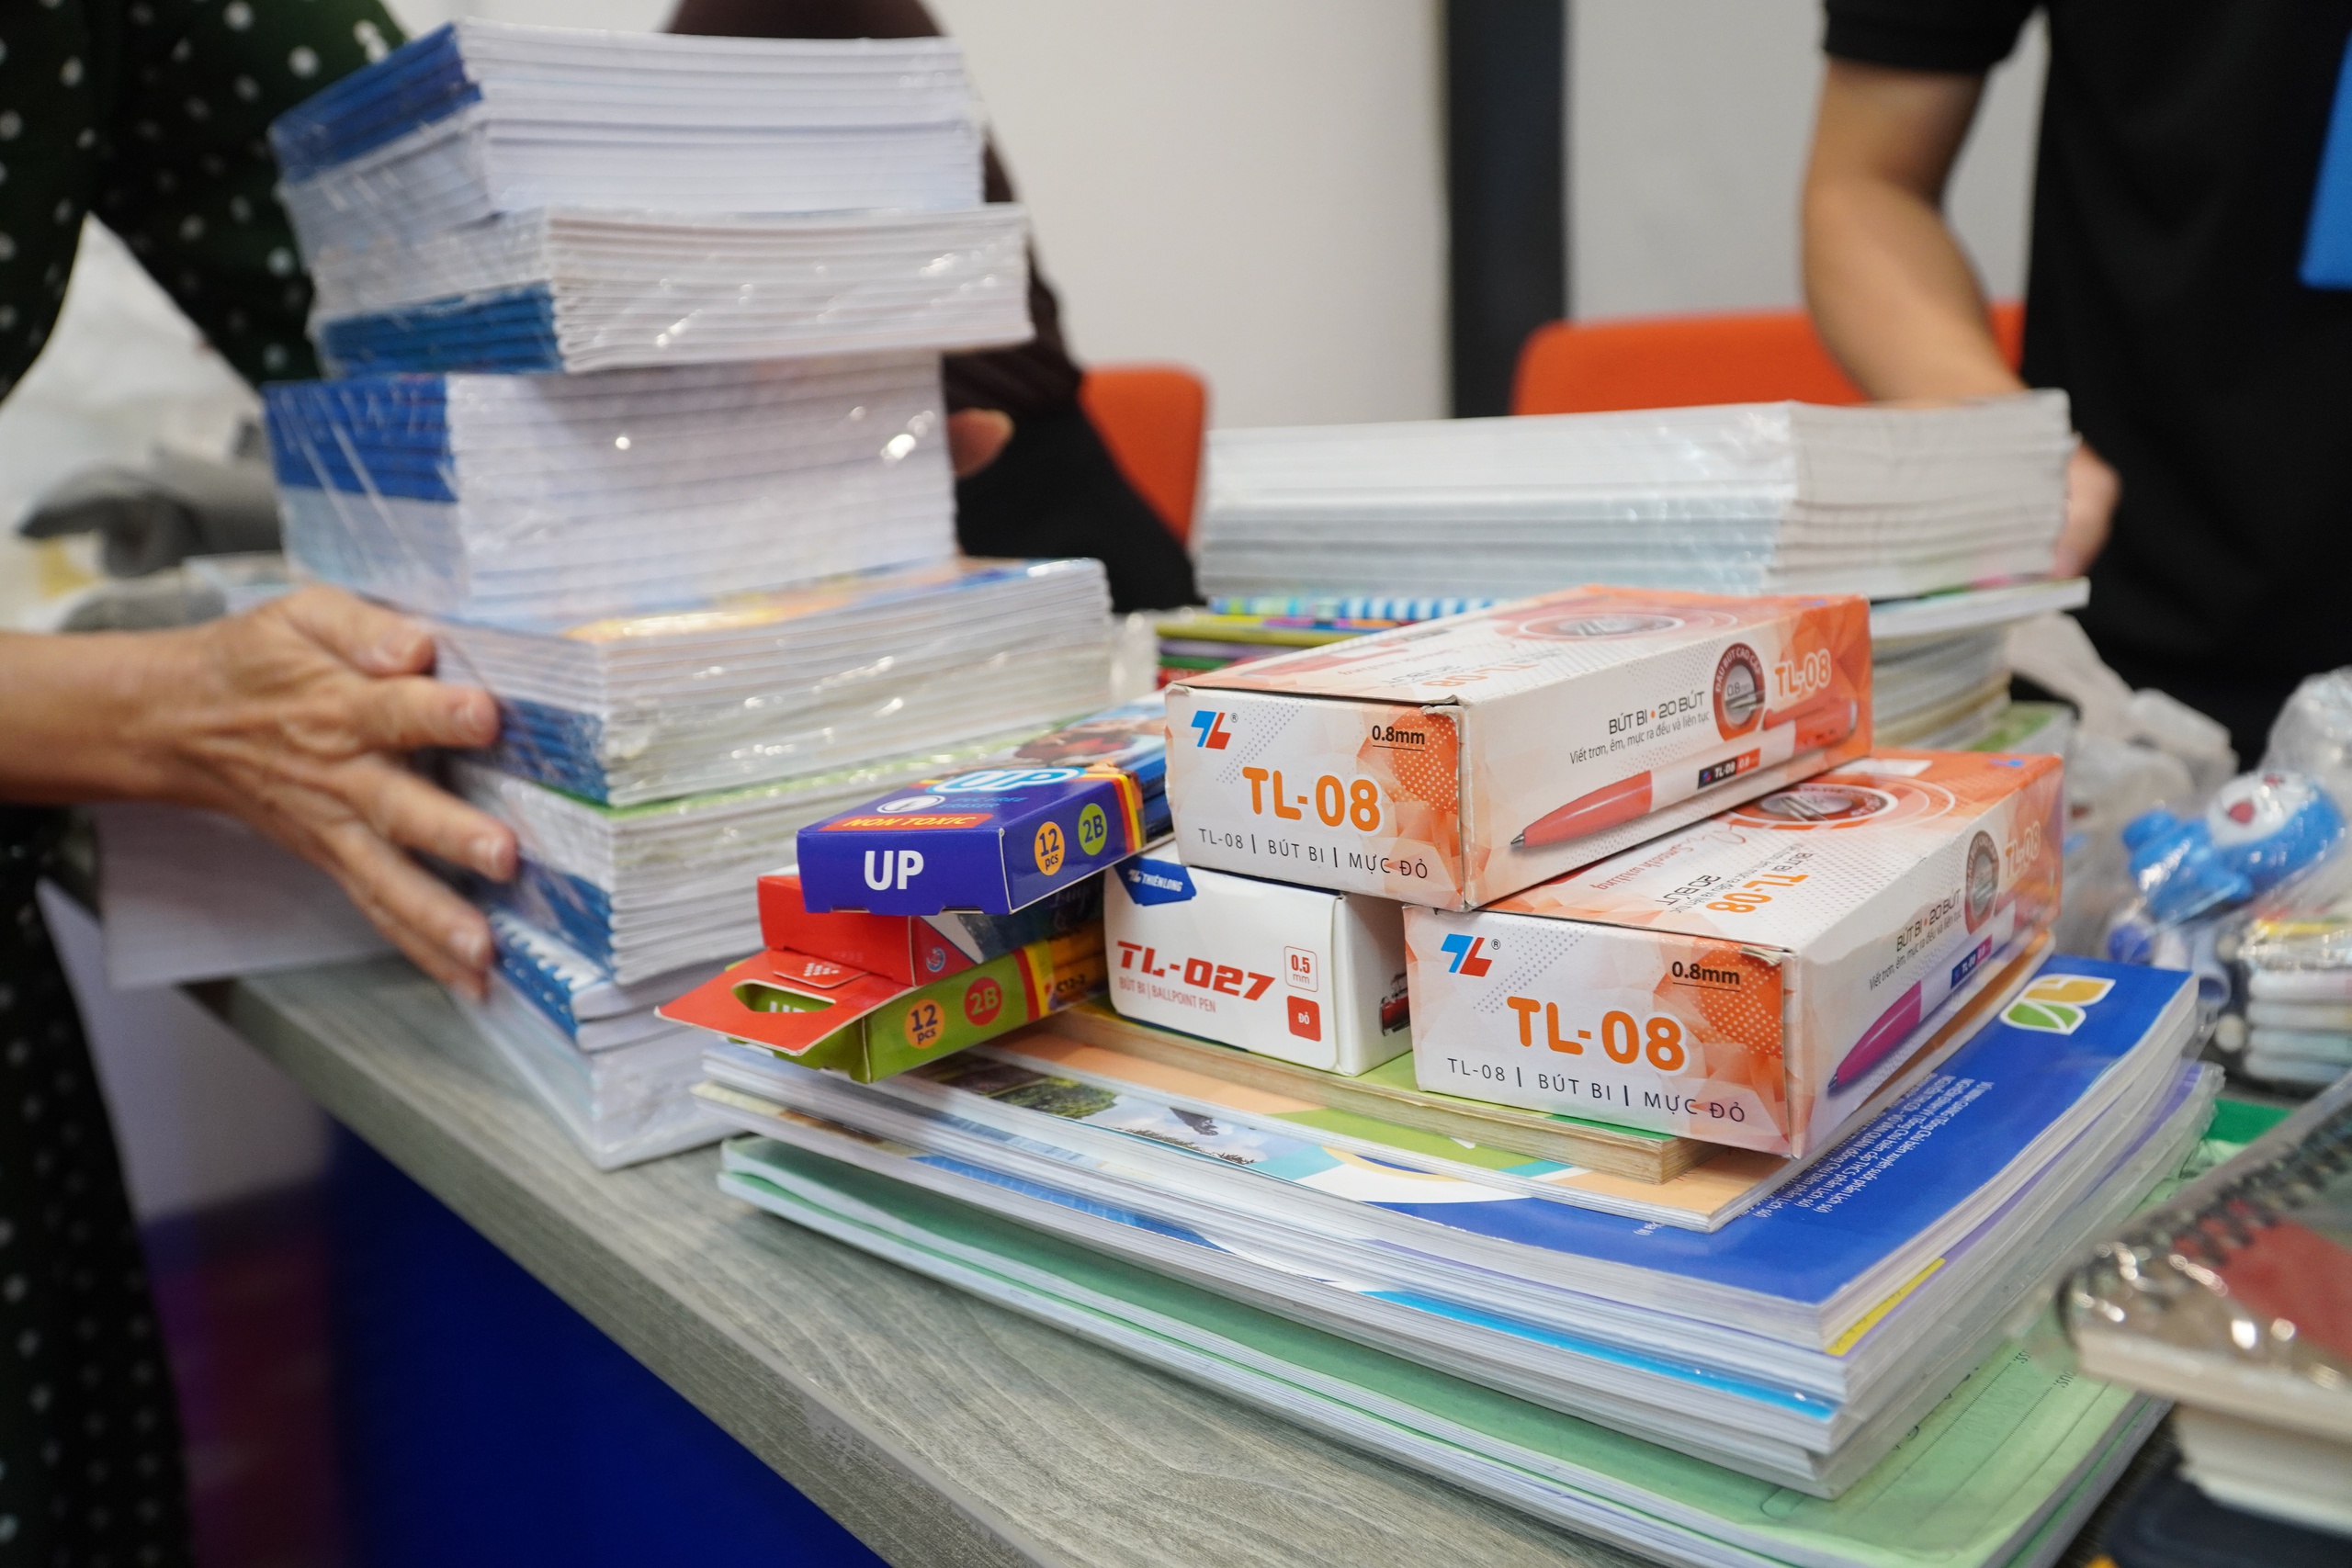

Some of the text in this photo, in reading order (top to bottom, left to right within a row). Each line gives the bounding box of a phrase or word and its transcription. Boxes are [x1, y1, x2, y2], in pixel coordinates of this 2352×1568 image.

[1775, 648, 1831, 698] TL-08
[1609, 690, 1704, 735] BÚT BI 20 BÚT
[1372, 725, 1425, 745] 0.8mm
[1569, 745, 1586, 764] Viết
[1627, 731, 1644, 749] mực
[1646, 728, 1653, 739] ra
[1656, 719, 1669, 737] đều
[1672, 719, 1679, 731] và
[1682, 712, 1695, 728] liên
[1698, 709, 1710, 724] tục
[932, 768, 1080, 793] UP
[1242, 766, 1381, 832] TL-08
[845, 816, 978, 827] NON TOXIC
[1082, 813, 1104, 843] 2B
[1039, 828, 1059, 857] 12
[1198, 829, 1428, 879] TL-08 BÚT BI MỰC ĐỎ
[864, 850, 924, 890] UP
[1045, 853, 1059, 871] pcs
[1655, 875, 1721, 906] 20 BÚT
[1706, 874, 1809, 913] TL-08
[1896, 887, 1960, 953] BÚT BI 20 BÚT
[1117, 940, 1275, 1001] TL-027
[1291, 953, 1311, 974] 0.5
[1671, 961, 1740, 985] 0.8mm
[1293, 973, 1310, 984] mm
[969, 987, 999, 1016] 2B
[1119, 976, 1216, 1013] BÚT BI BALLPOINT PEN
[911, 1004, 937, 1032] 12
[1298, 1011, 1310, 1025] ĐỎ
[916, 1028, 937, 1044] pcs
[1507, 996, 1684, 1071] TL-08
[1447, 1057, 1746, 1122] TL-08 BÚT BI MỰC ĐỎ
[1870, 1139, 1897, 1152] biên
[1893, 1140, 1919, 1153] biên
[1840, 1160, 1870, 1175] THCS
[1804, 1187, 1833, 1199] Lịch
[1823, 1192, 1851, 1204] Lịch
